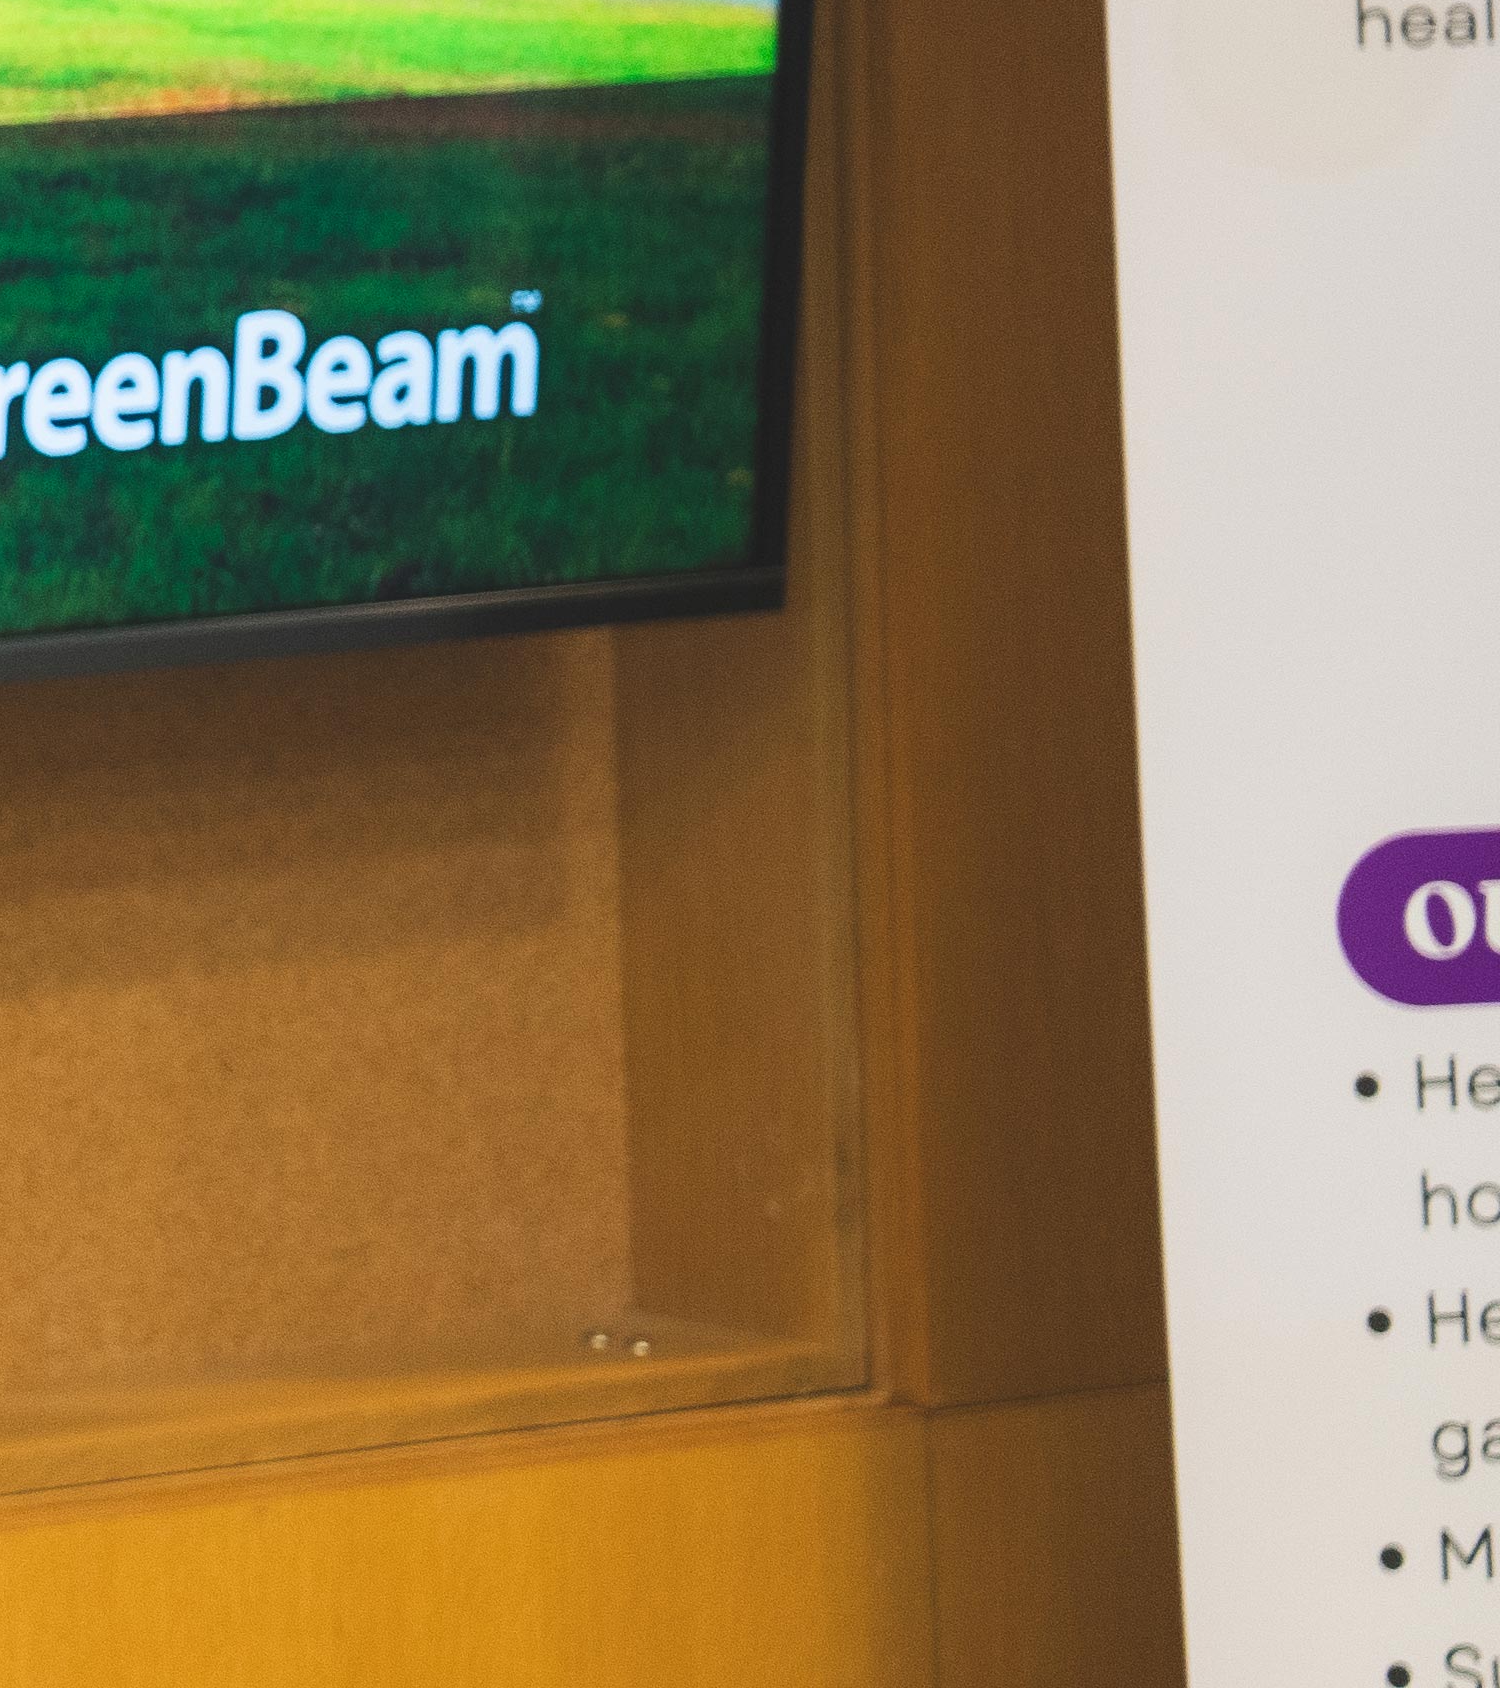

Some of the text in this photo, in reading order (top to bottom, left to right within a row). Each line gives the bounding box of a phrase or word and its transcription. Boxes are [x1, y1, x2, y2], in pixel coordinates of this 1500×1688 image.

[1403, 879, 1500, 961] O
[1415, 1054, 1500, 1110] He
[1444, 1642, 1500, 1688] S
